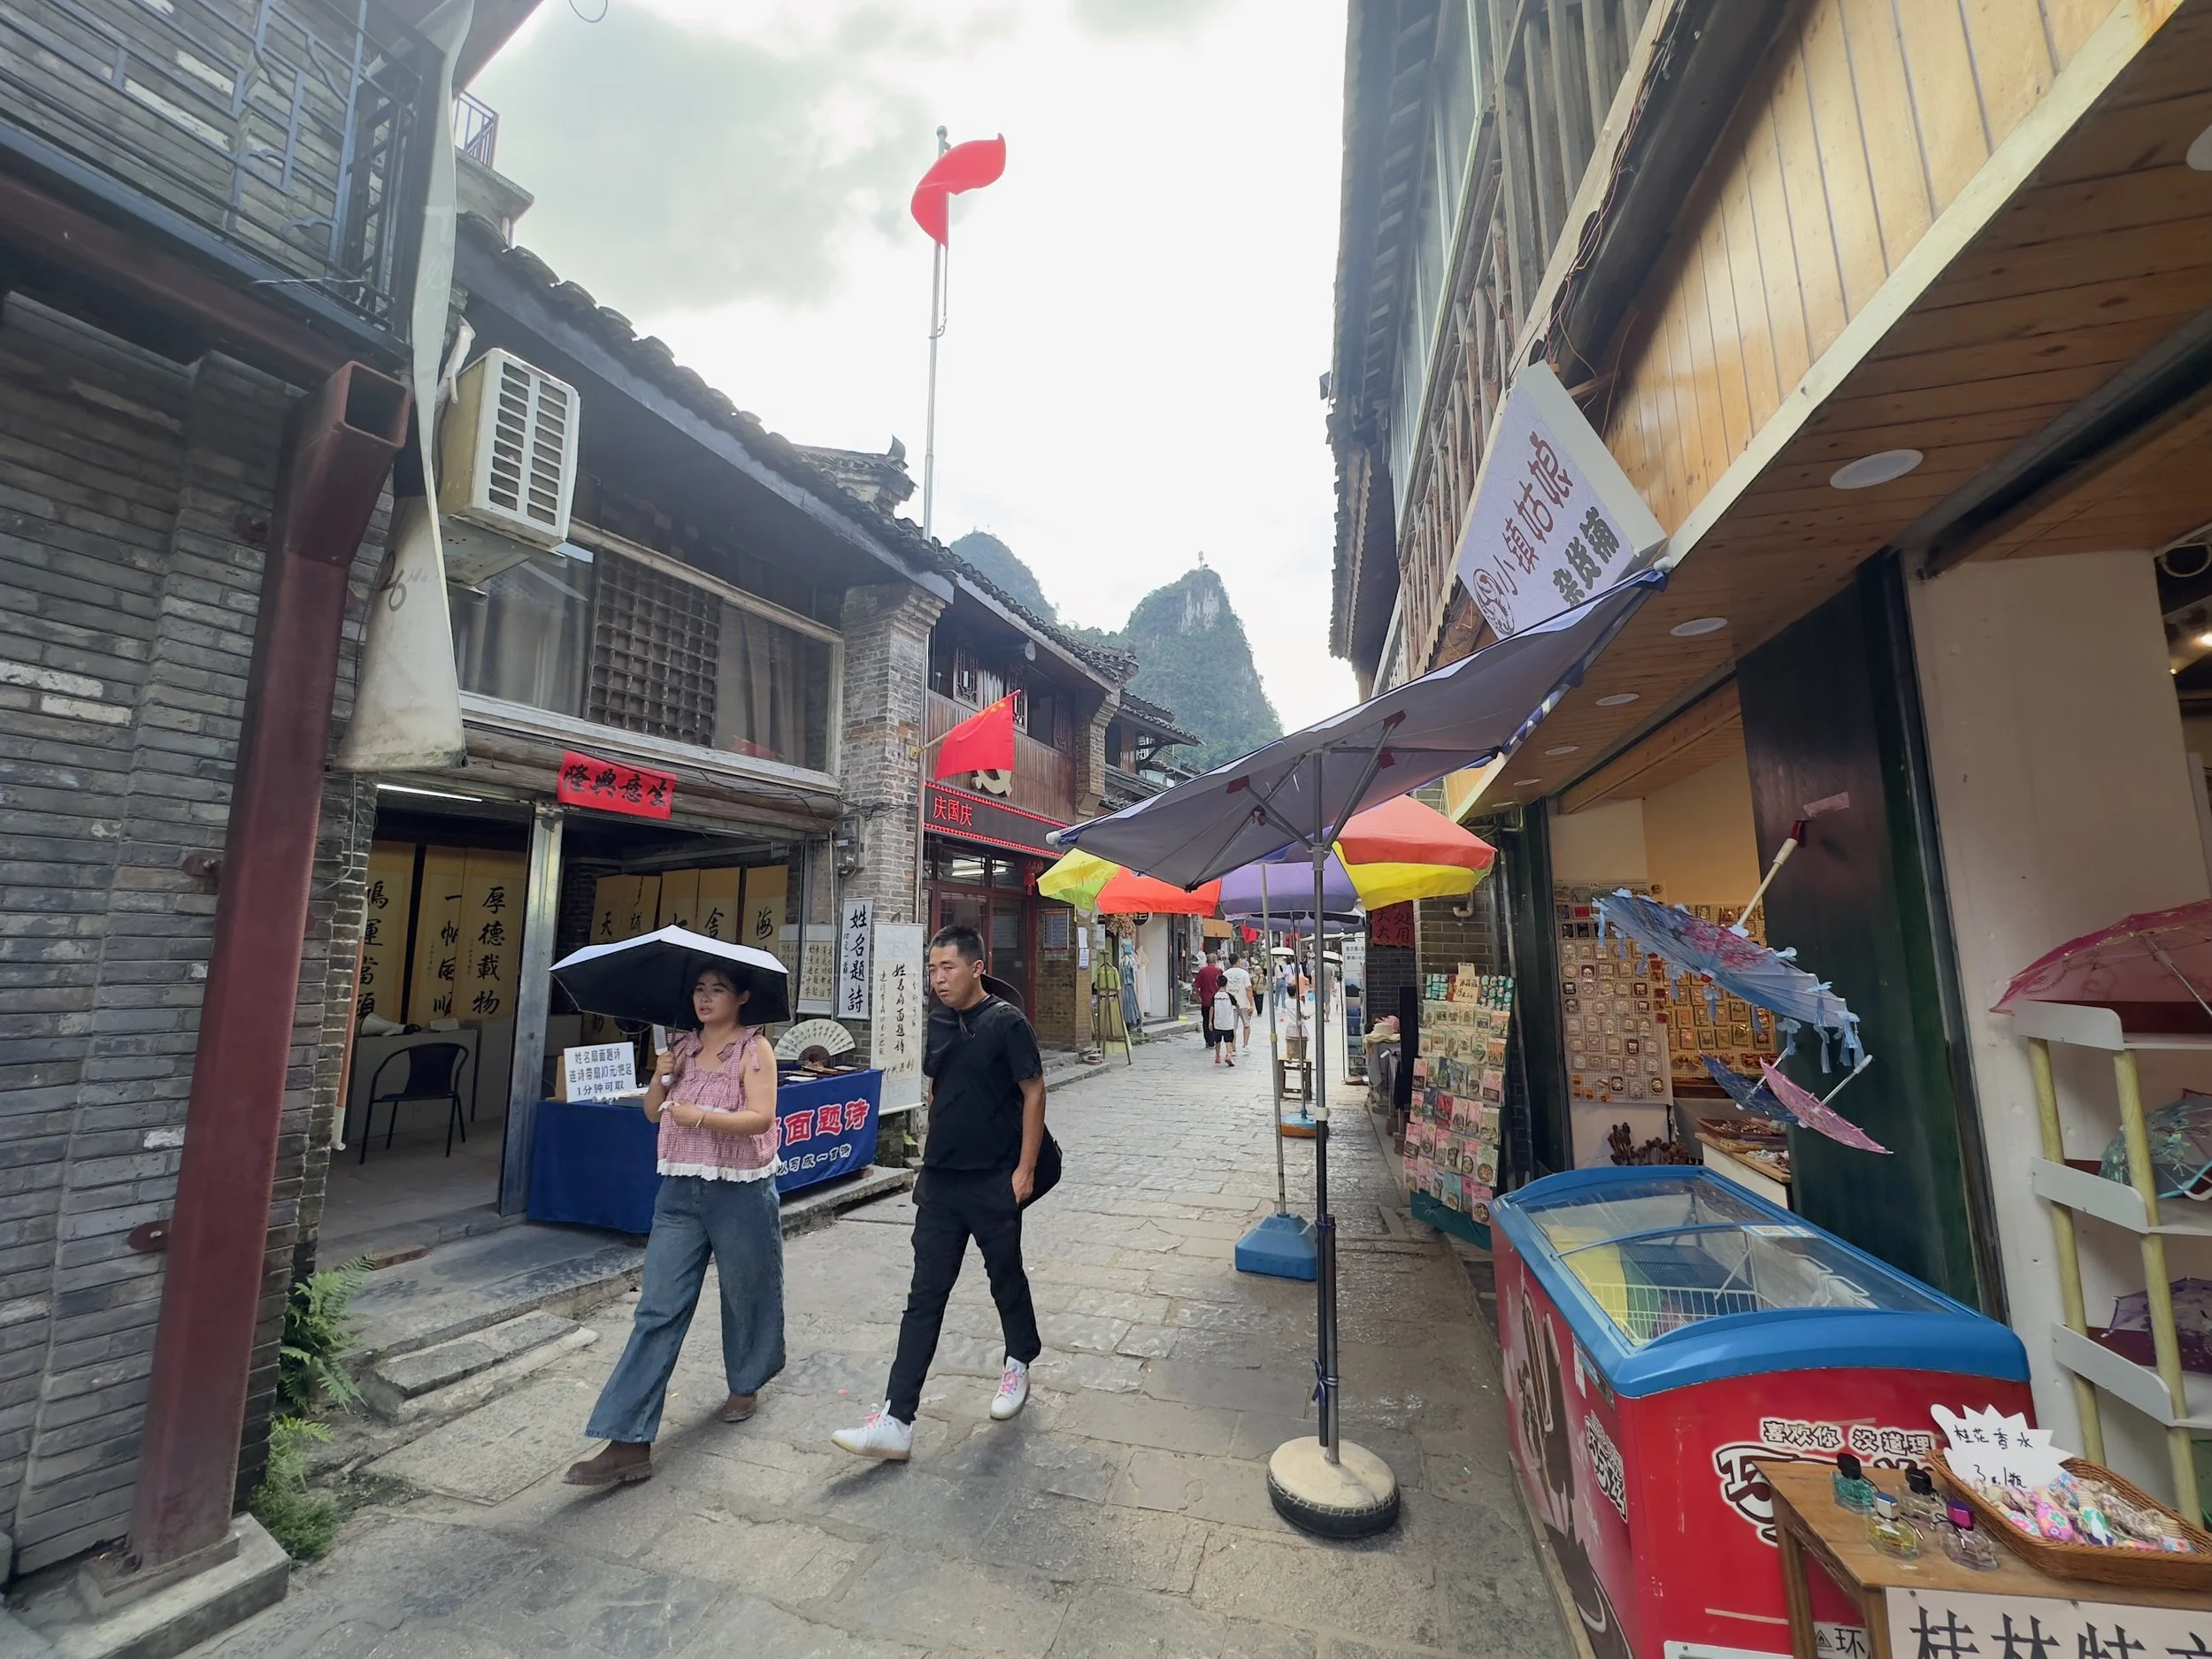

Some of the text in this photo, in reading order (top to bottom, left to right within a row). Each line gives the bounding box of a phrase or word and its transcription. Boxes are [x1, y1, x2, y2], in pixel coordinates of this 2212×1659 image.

[1494, 431, 1573, 596] 小镇姑娘
[1552, 506, 1621, 607] 杂货铺
[933, 795, 972, 826] 庆国庆
[574, 1048, 621, 1064] 姓名扇面题诗
[577, 1080, 625, 1096] 1分钟可取
[774, 1098, 871, 1150] 面题诗
[1954, 1425, 2033, 1450] 桂花香水
